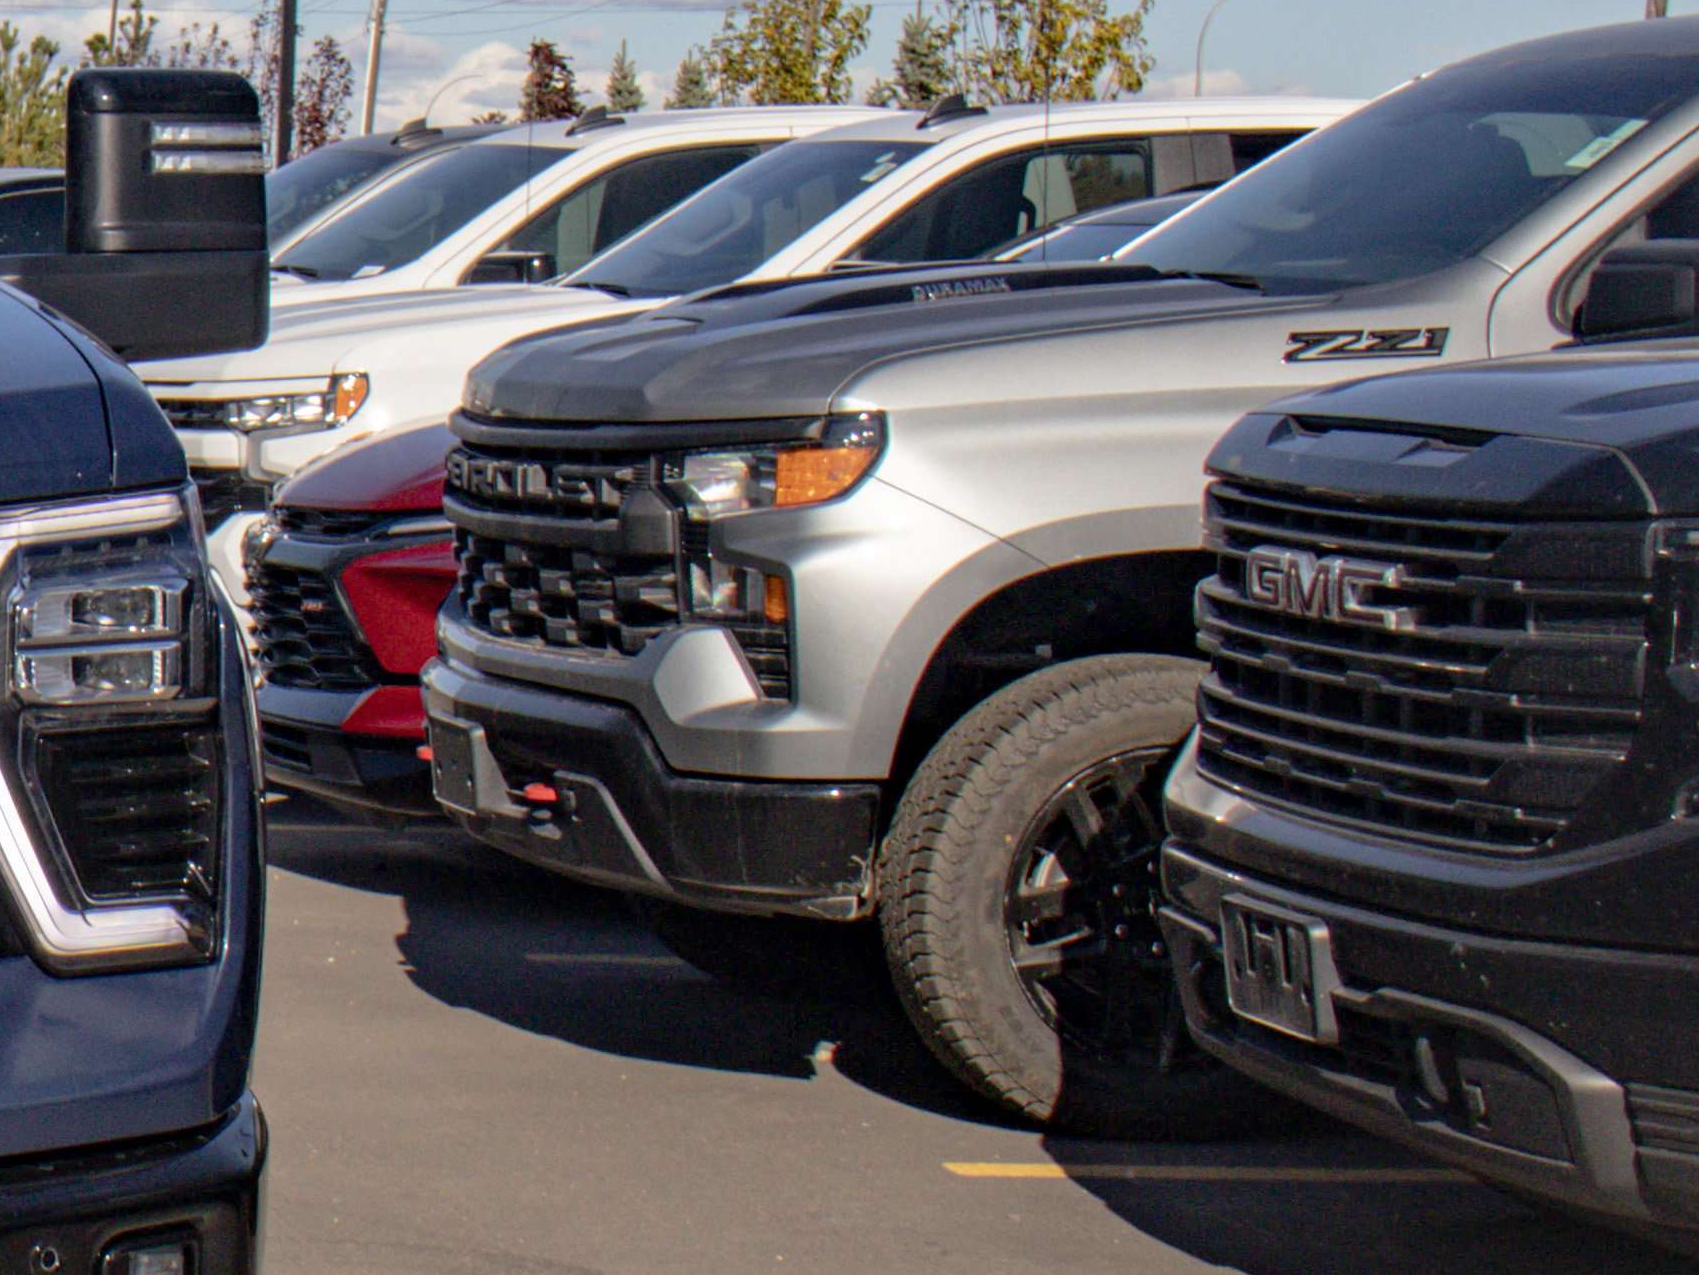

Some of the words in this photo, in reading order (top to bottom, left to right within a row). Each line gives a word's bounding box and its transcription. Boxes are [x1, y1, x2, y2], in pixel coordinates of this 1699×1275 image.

[912, 275, 1012, 302] DURAMAX
[1281, 327, 1450, 363] Z71
[1247, 545, 1414, 631] GMC
